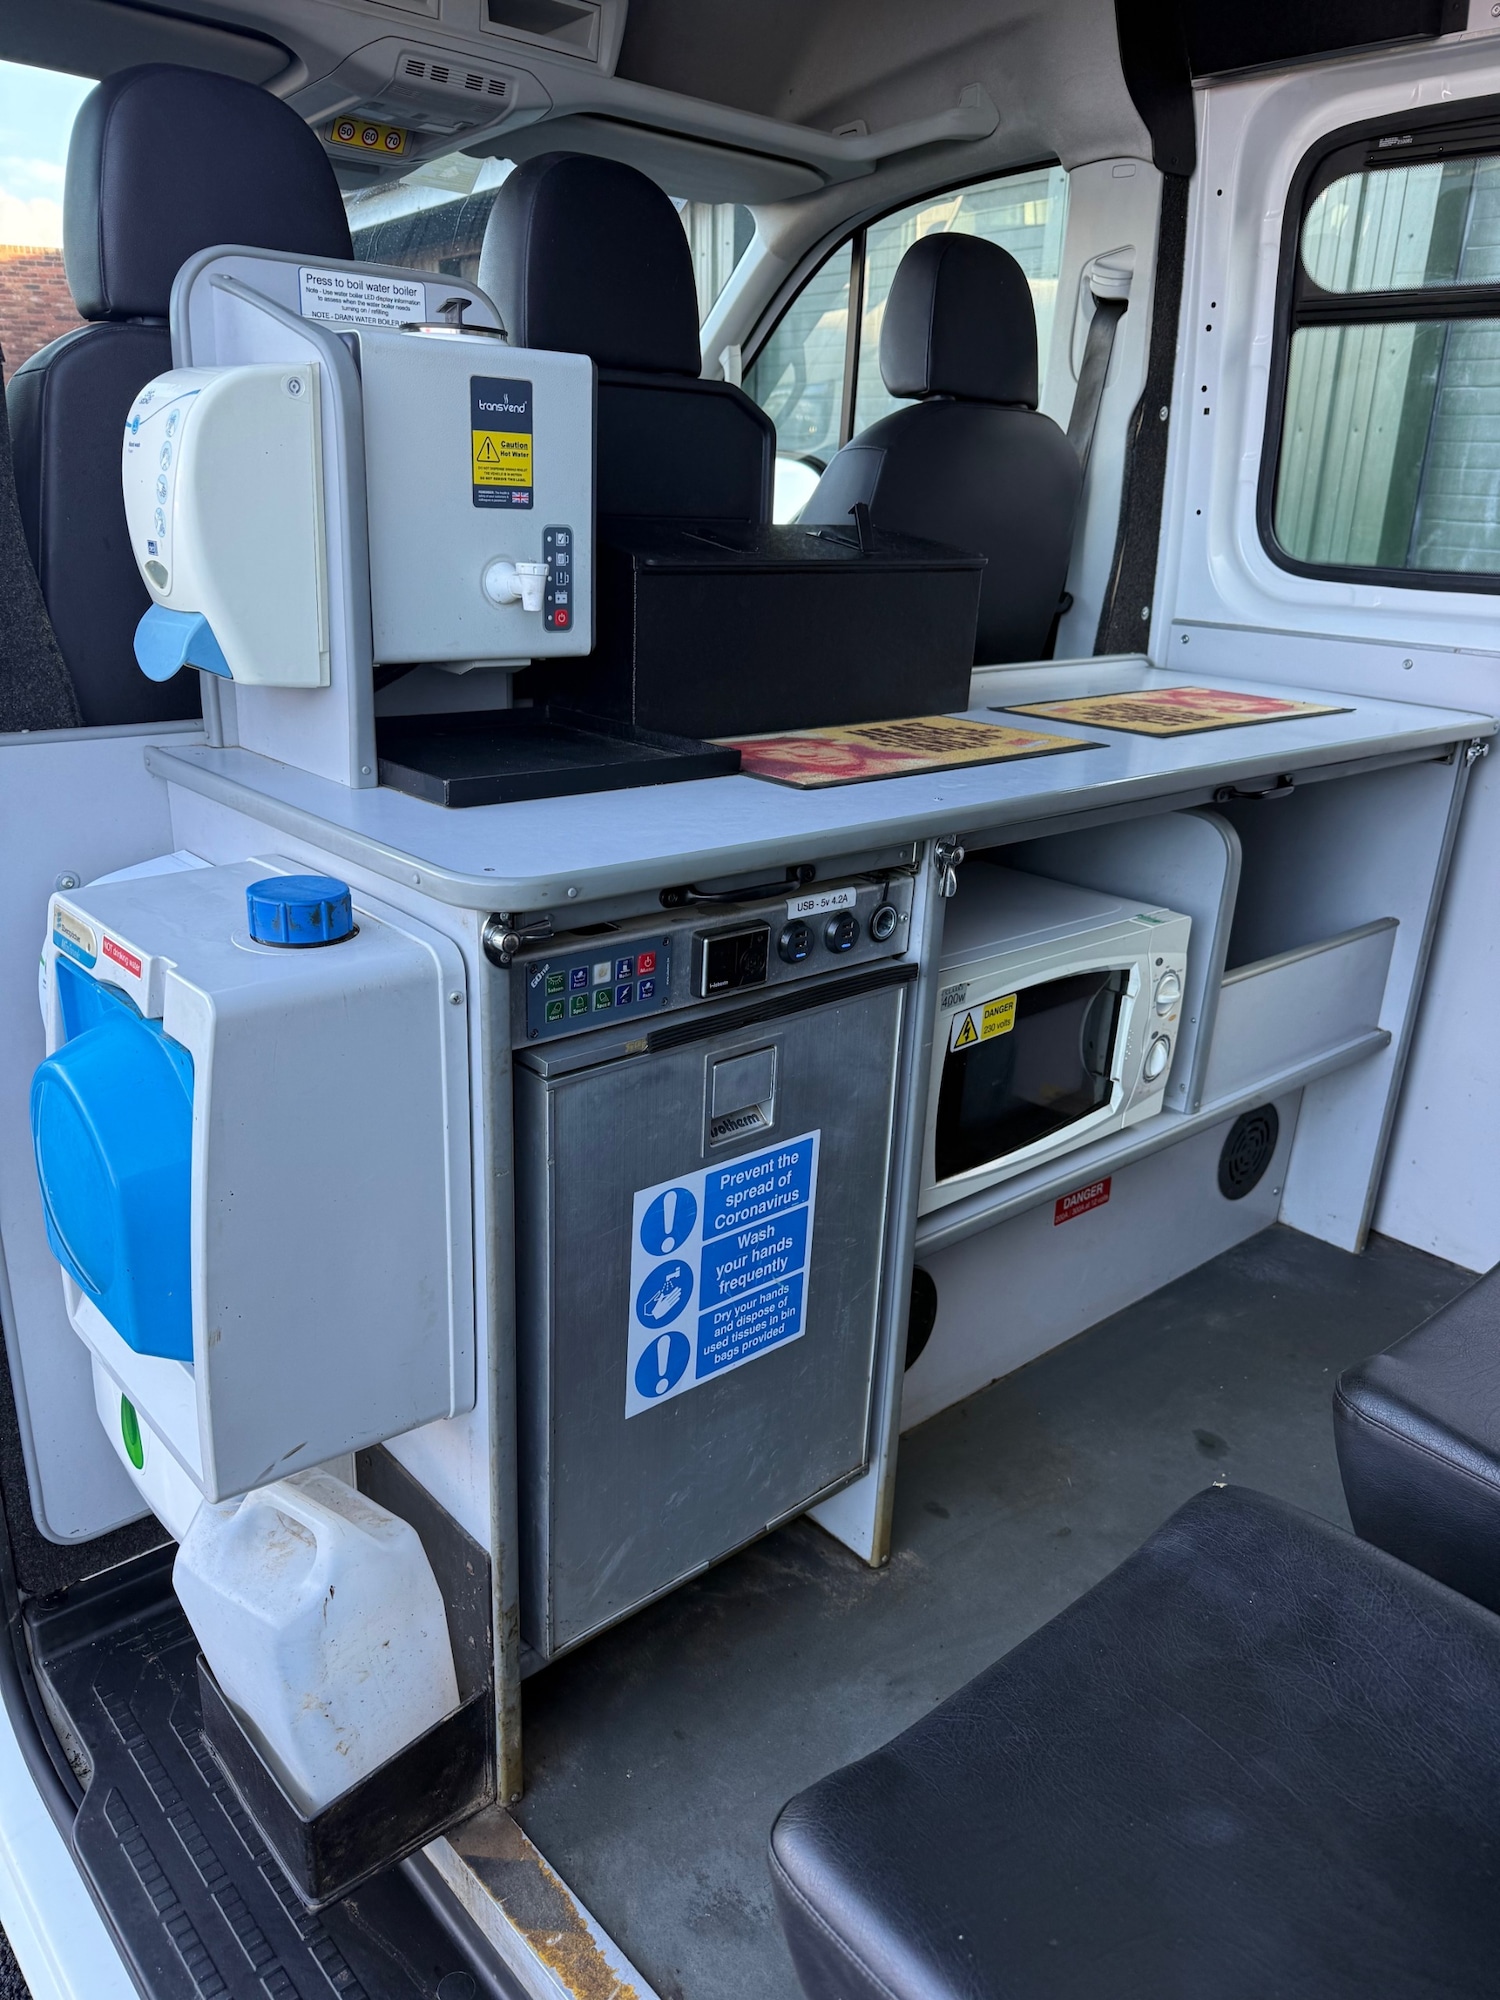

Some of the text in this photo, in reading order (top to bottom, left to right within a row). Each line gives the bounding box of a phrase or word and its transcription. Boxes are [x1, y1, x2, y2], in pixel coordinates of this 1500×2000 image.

[341, 126, 352, 136] 50
[364, 131, 376, 141] 60
[388, 136, 398, 146] 70
[306, 273, 418, 296] Press to boil water boiler
[341, 305, 359, 313] turning
[371, 309, 389, 317] refilling
[375, 294, 393, 303] display
[394, 297, 421, 306] information
[381, 302, 395, 310] boiler
[395, 304, 411, 312] needs
[311, 310, 330, 319] NOTE
[334, 313, 354, 322] DRAIN
[355, 315, 377, 324] WATER
[377, 317, 400, 327] BOILER
[478, 399, 526, 413] transvend
[501, 440, 528, 449] Caution
[797, 900, 815, 911] USB
[820, 898, 830, 907] 5v
[831, 894, 848, 905] 4.2A
[103, 941, 141, 972] NOT drinking water
[984, 1001, 1013, 1018] DANGER
[983, 1018, 1011, 1034] 230 volts
[720, 1152, 799, 1189] Prevent the
[725, 1170, 793, 1208] spread of
[1063, 1182, 1104, 1210] DANGER
[714, 1189, 800, 1230] Coronavirus
[737, 1224, 775, 1249] Wash
[716, 1237, 793, 1280] your hands
[719, 1256, 788, 1295] frequently
[714, 1284, 790, 1325] Dry your hands
[714, 1297, 788, 1338] and dispose of
[703, 1306, 796, 1356] used tissues in bin
[714, 1324, 785, 1364] bags provided
